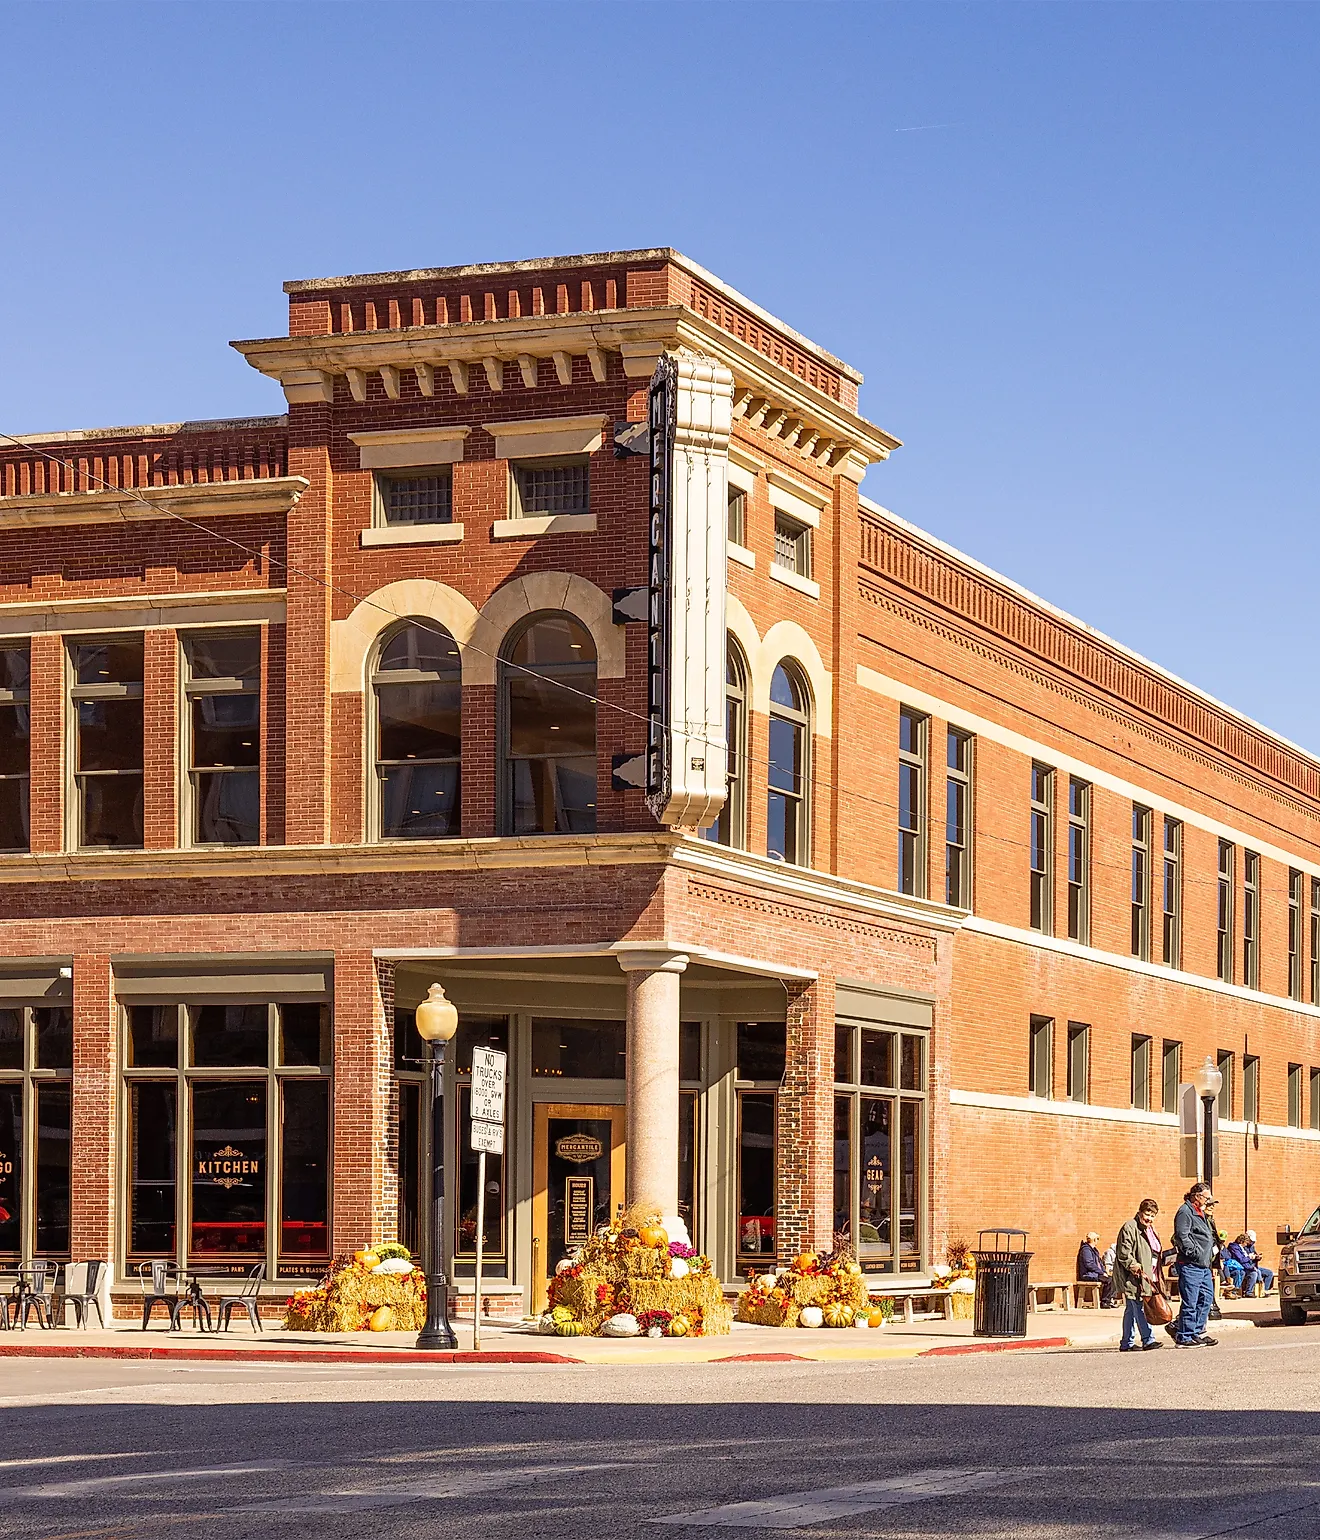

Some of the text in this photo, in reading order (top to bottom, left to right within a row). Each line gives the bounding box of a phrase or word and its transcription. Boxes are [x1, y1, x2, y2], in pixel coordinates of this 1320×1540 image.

[651, 391, 664, 787] MERCANTILE
[485, 1053, 494, 1067] NO
[476, 1066, 502, 1081] TRUCKS
[481, 1079, 495, 1089] OVER
[482, 1108, 499, 1118] AXLES
[478, 1138, 496, 1149] EXEMPT
[198, 1161, 259, 1174] KITCHEN
[866, 1169, 884, 1181] GEAR
